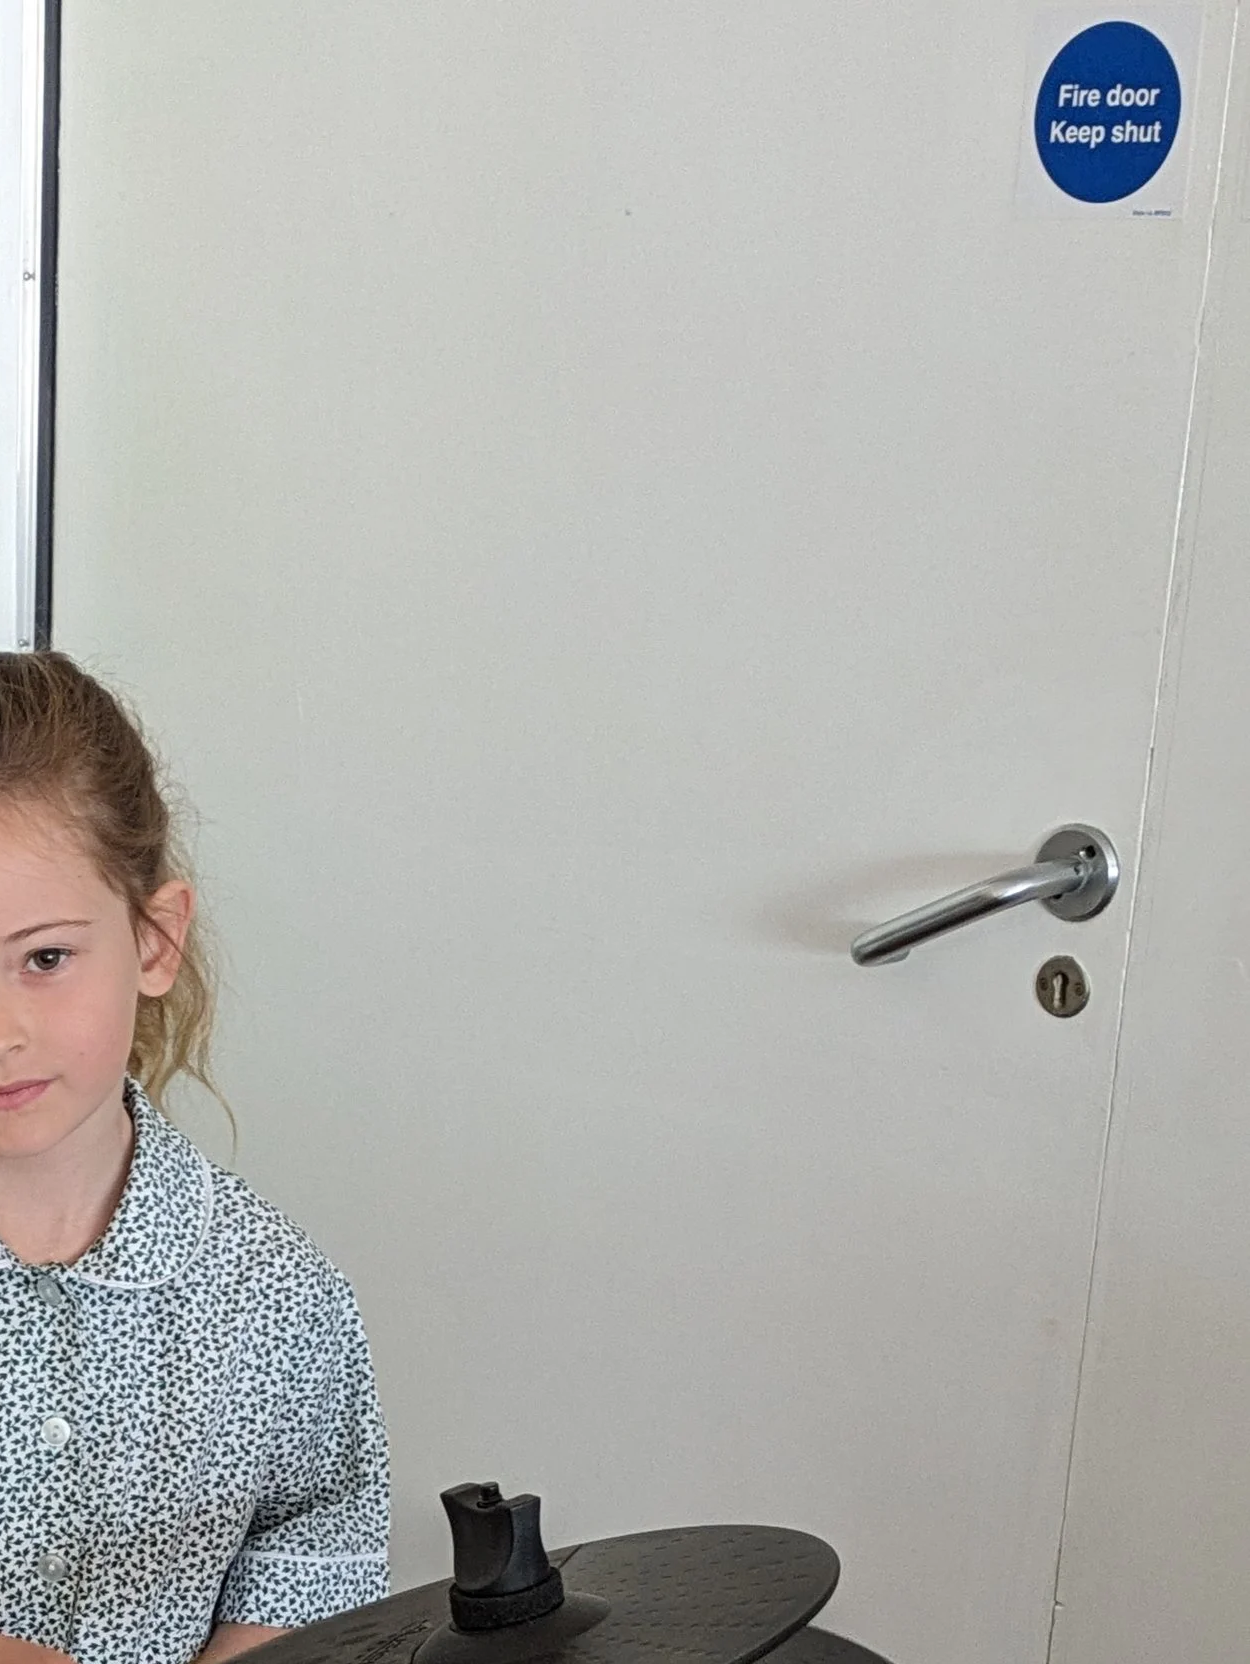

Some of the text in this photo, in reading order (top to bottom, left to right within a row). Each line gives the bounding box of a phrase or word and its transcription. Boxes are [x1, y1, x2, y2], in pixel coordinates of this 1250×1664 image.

[1058, 83, 1161, 107] Fire door
[1049, 120, 1162, 149] Keep shut
